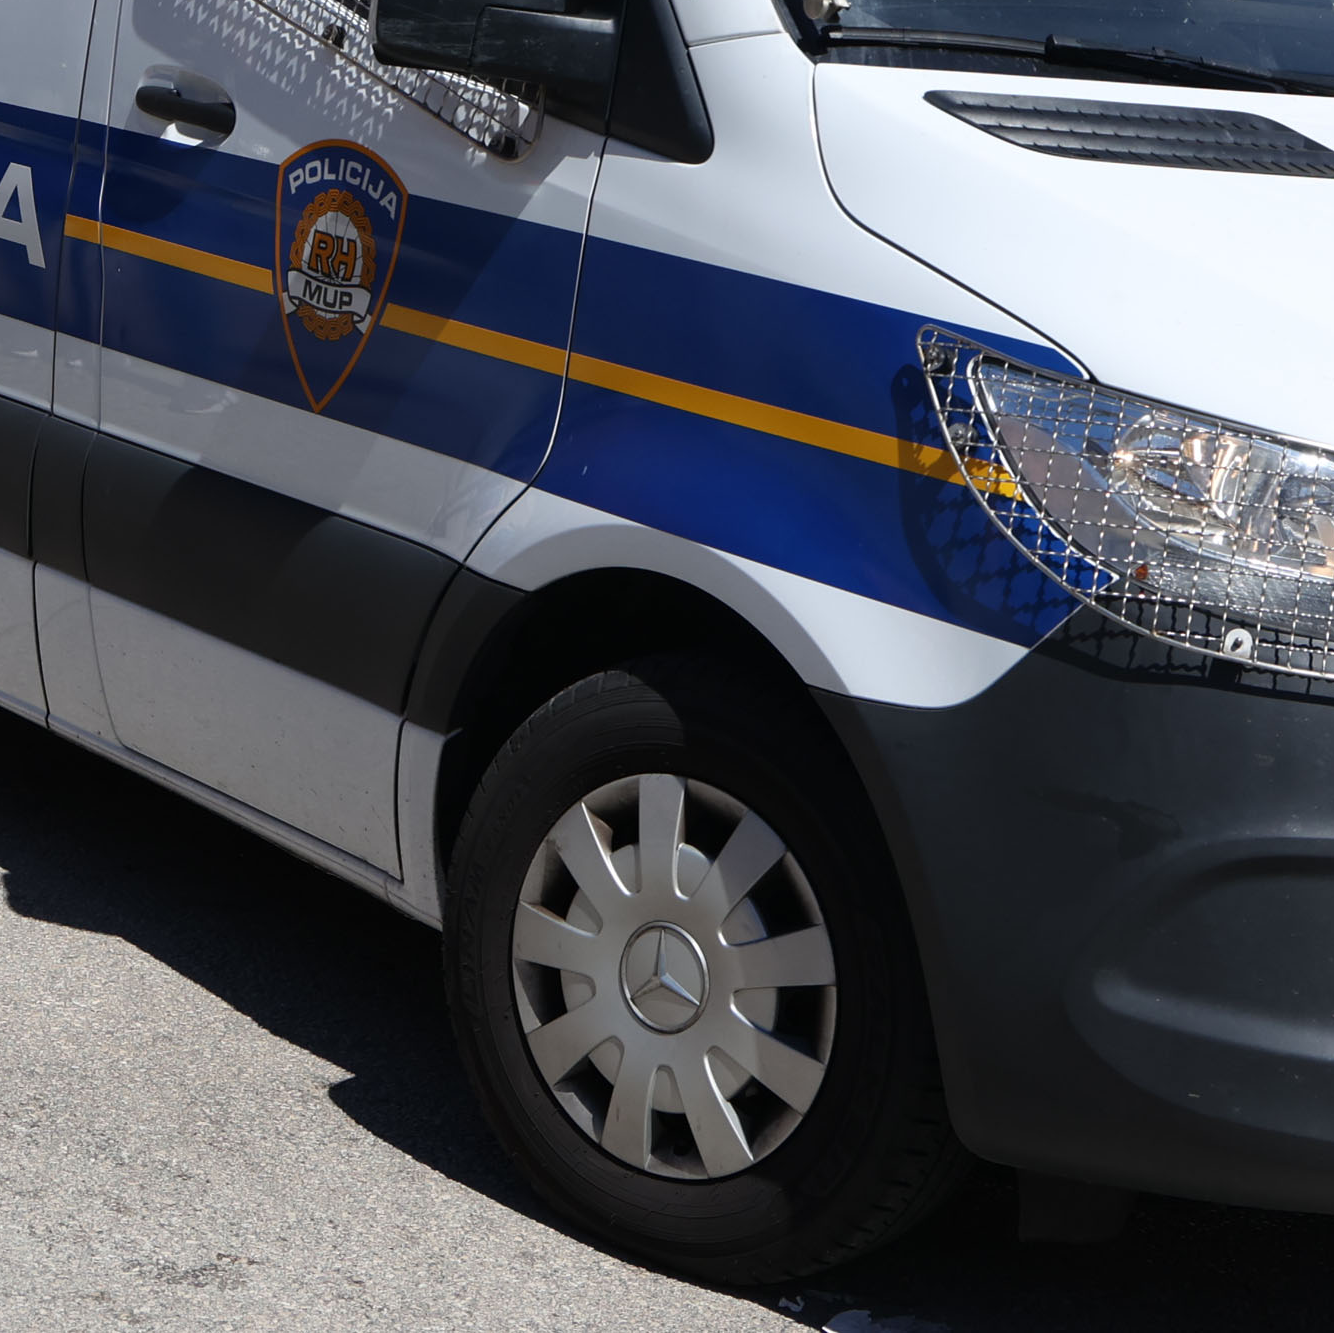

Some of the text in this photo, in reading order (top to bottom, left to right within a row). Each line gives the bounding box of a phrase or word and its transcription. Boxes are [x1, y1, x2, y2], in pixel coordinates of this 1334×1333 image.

[289, 158, 397, 221] POLICIJA
[308, 230, 357, 282] RH
[302, 279, 353, 310] MUP
